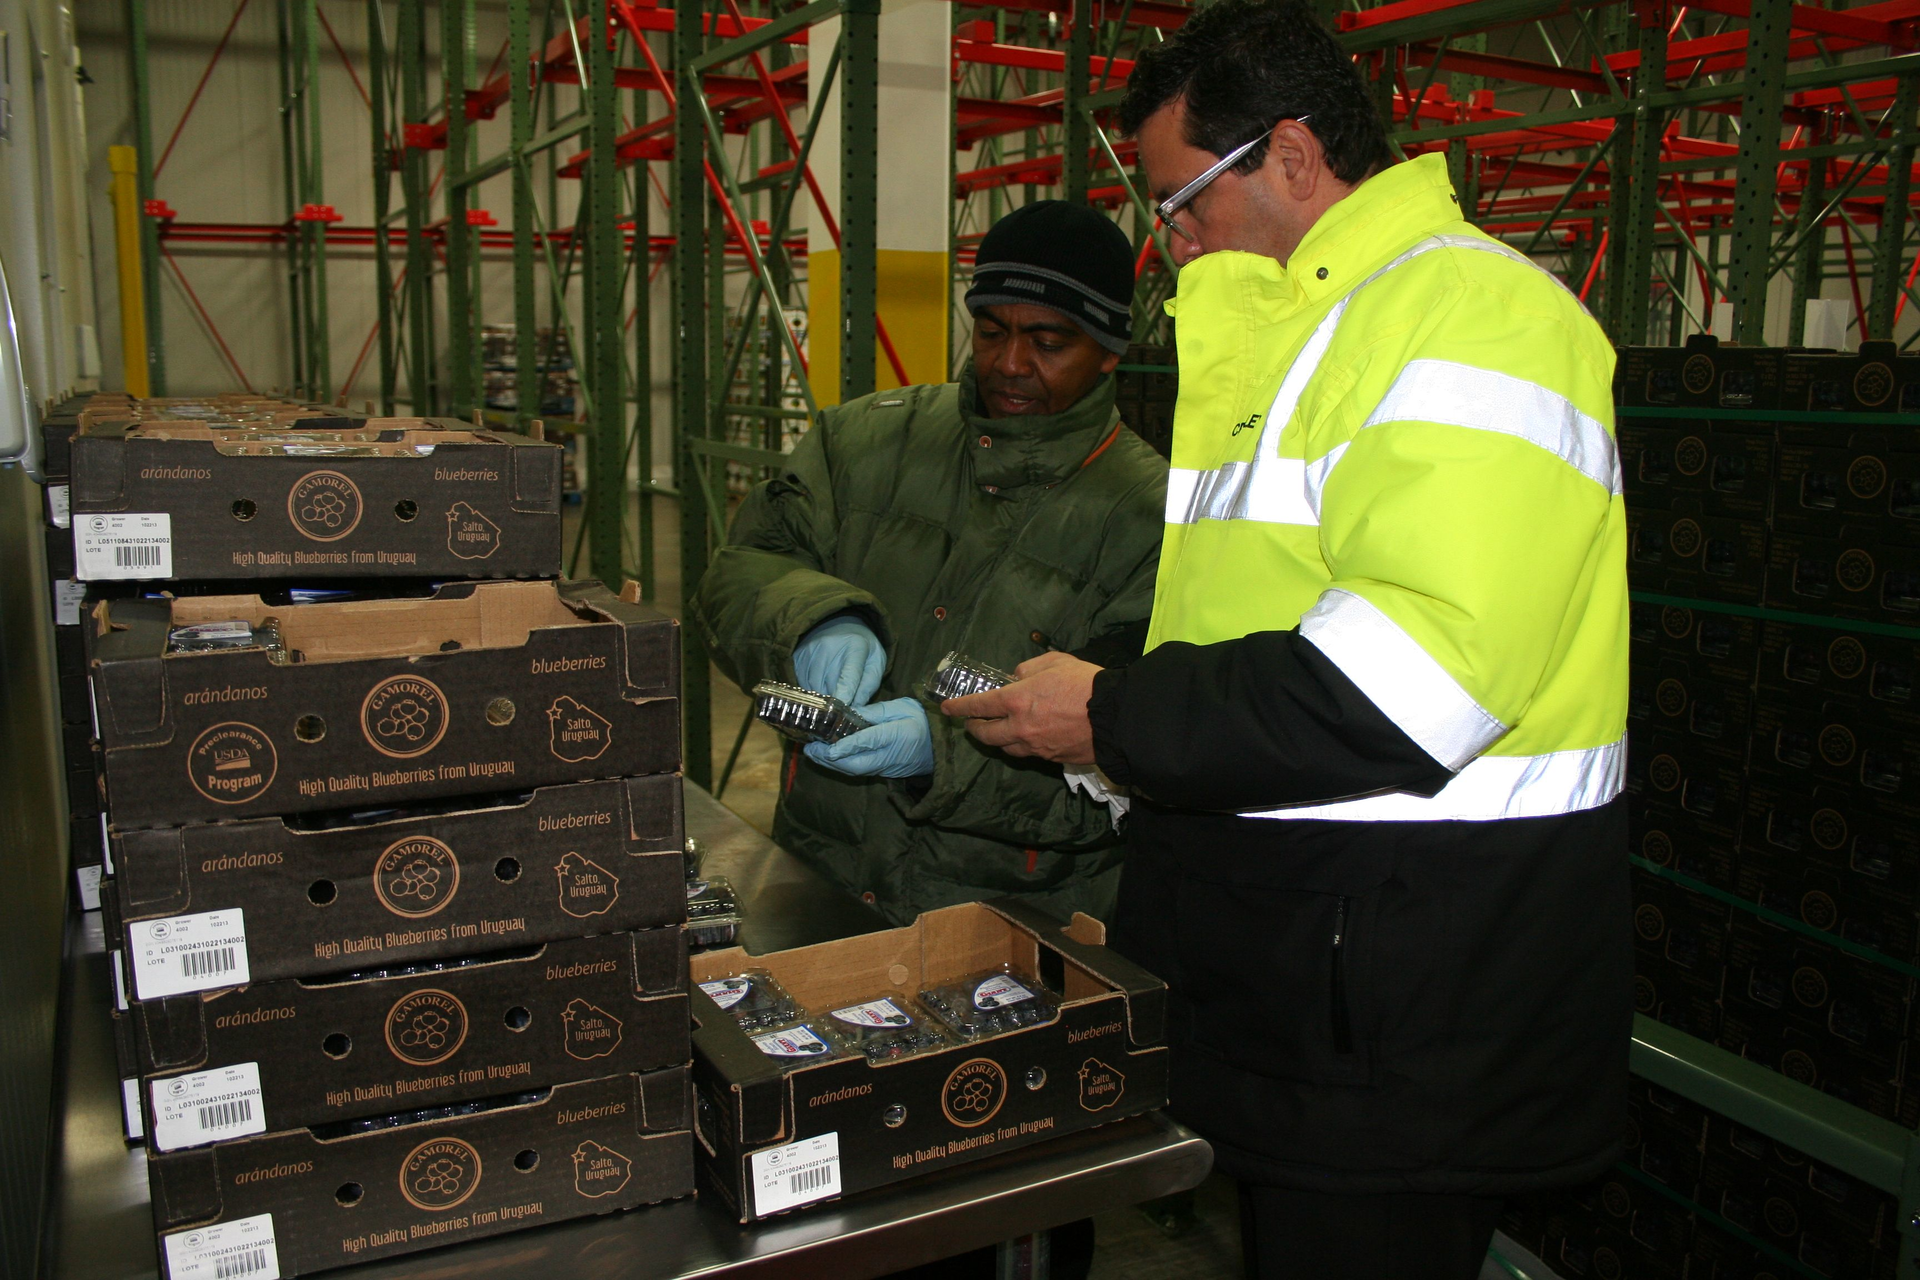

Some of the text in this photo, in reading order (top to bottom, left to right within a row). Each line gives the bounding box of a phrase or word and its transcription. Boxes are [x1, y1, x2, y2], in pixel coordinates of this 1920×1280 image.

[140, 465, 211, 479] arándanos
[434, 468, 499, 481] blueberries
[298, 476, 352, 499] GAMOREL
[462, 522, 485, 533] Salto,
[457, 532, 490, 543] Uruguay
[232, 550, 416, 566] High Quality Blueberries from Uruguay
[531, 655, 606, 674] blueberries
[184, 685, 268, 705] arándanos
[372, 682, 435, 711] GAMOREL
[567, 718, 593, 731] Salto,
[199, 731, 262, 755] Preclearance
[561, 729, 600, 743] Uruguay
[214, 748, 250, 760] USDA
[208, 773, 262, 792] Program
[300, 760, 515, 796] High Quality Blueberries from Uruguay
[538, 811, 611, 832] blueberries
[201, 851, 284, 873] arándanos
[384, 843, 447, 871] GAMOREL
[575, 874, 600, 885] Salto,
[569, 883, 607, 898] Uruguay
[160, 936, 244, 954] L031002431022134002
[314, 917, 526, 960] High Quality Blueberries from Uruguay
[147, 958, 166, 966] LOTE
[546, 958, 617, 981] blueberries
[215, 1006, 296, 1029] arándanos
[395, 995, 456, 1023] GAMOREL
[575, 1026, 611, 1042] Uruguay
[580, 1018, 605, 1031] Salto,
[1067, 1021, 1122, 1044] blueberries
[326, 1061, 531, 1107] High Quality Blueberries from Uruguay
[950, 1063, 997, 1091] GAMOREL
[1091, 1073, 1110, 1085] Salto,
[809, 1082, 873, 1108] arándanos
[1087, 1081, 1116, 1096] Uruguay
[178, 1088, 260, 1110] L031002431022134002
[556, 1102, 626, 1125] blueberries
[892, 1116, 1054, 1169] High Quality Blueberries from Uruguay
[409, 1144, 469, 1171] GAMOREL
[590, 1157, 614, 1169] Salto,
[235, 1160, 314, 1185] arándanos
[585, 1165, 620, 1181] Uruguay
[764, 1180, 778, 1188] LOTE
[343, 1202, 543, 1254] High Quality Blueberries from Uruguay
[182, 1264, 200, 1272] LOTE
